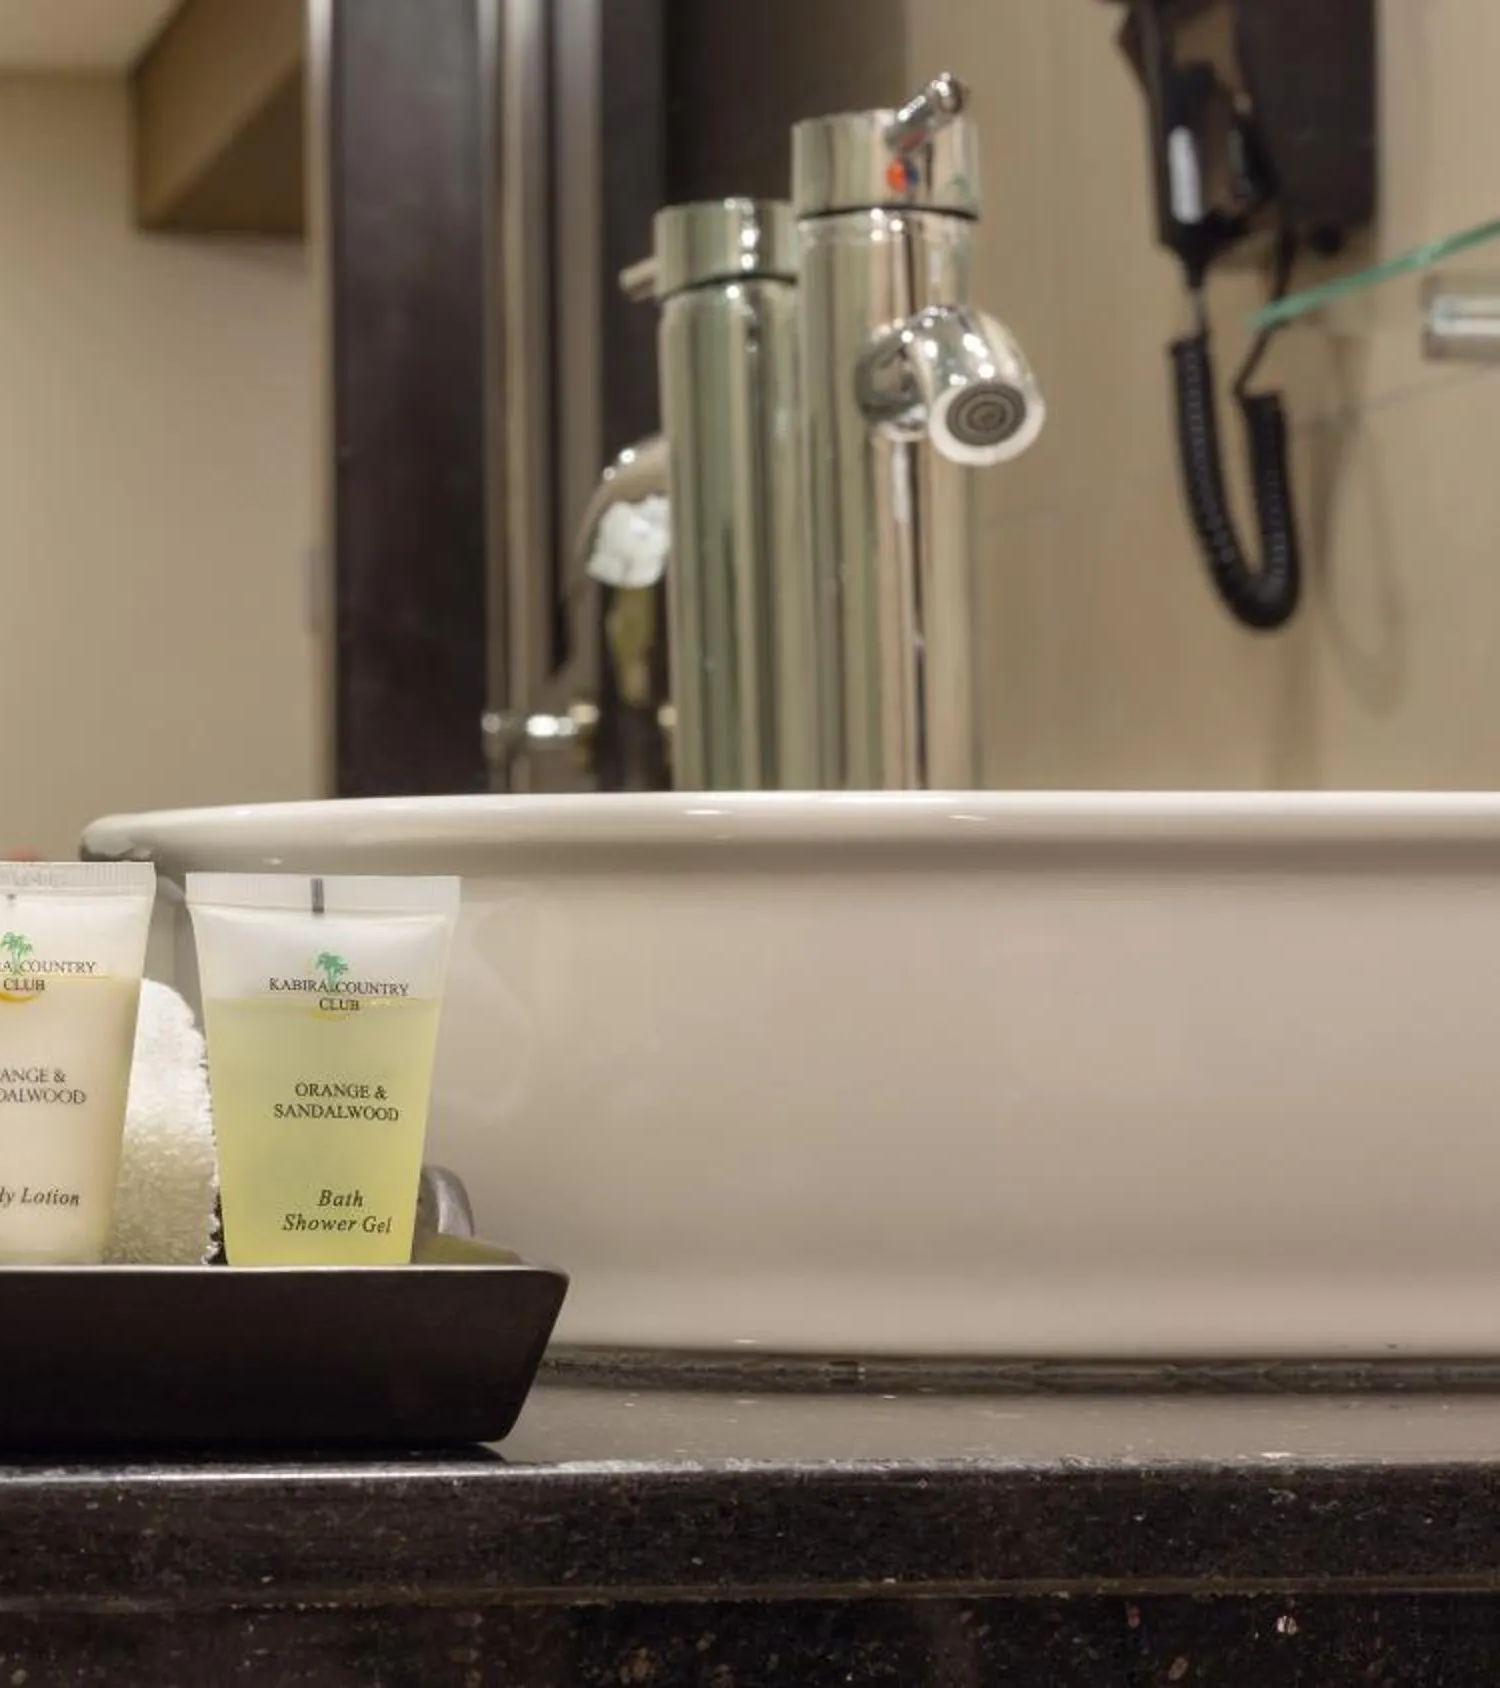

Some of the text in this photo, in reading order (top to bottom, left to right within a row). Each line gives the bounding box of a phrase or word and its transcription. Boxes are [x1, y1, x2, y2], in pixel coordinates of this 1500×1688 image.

[19, 960, 98, 974] COUNTRY
[3, 979, 45, 991] CLUB
[269, 977, 409, 996] KABIRA COUNTRY
[319, 999, 359, 1011] CLUB
[54, 1069, 66, 1083] &
[295, 1083, 388, 1100] ORANGE &
[273, 1104, 399, 1121] SANDALWOOD
[21, 1187, 80, 1207] Lotion
[318, 1190, 364, 1208] Bath
[282, 1214, 392, 1234] Shower Gel
